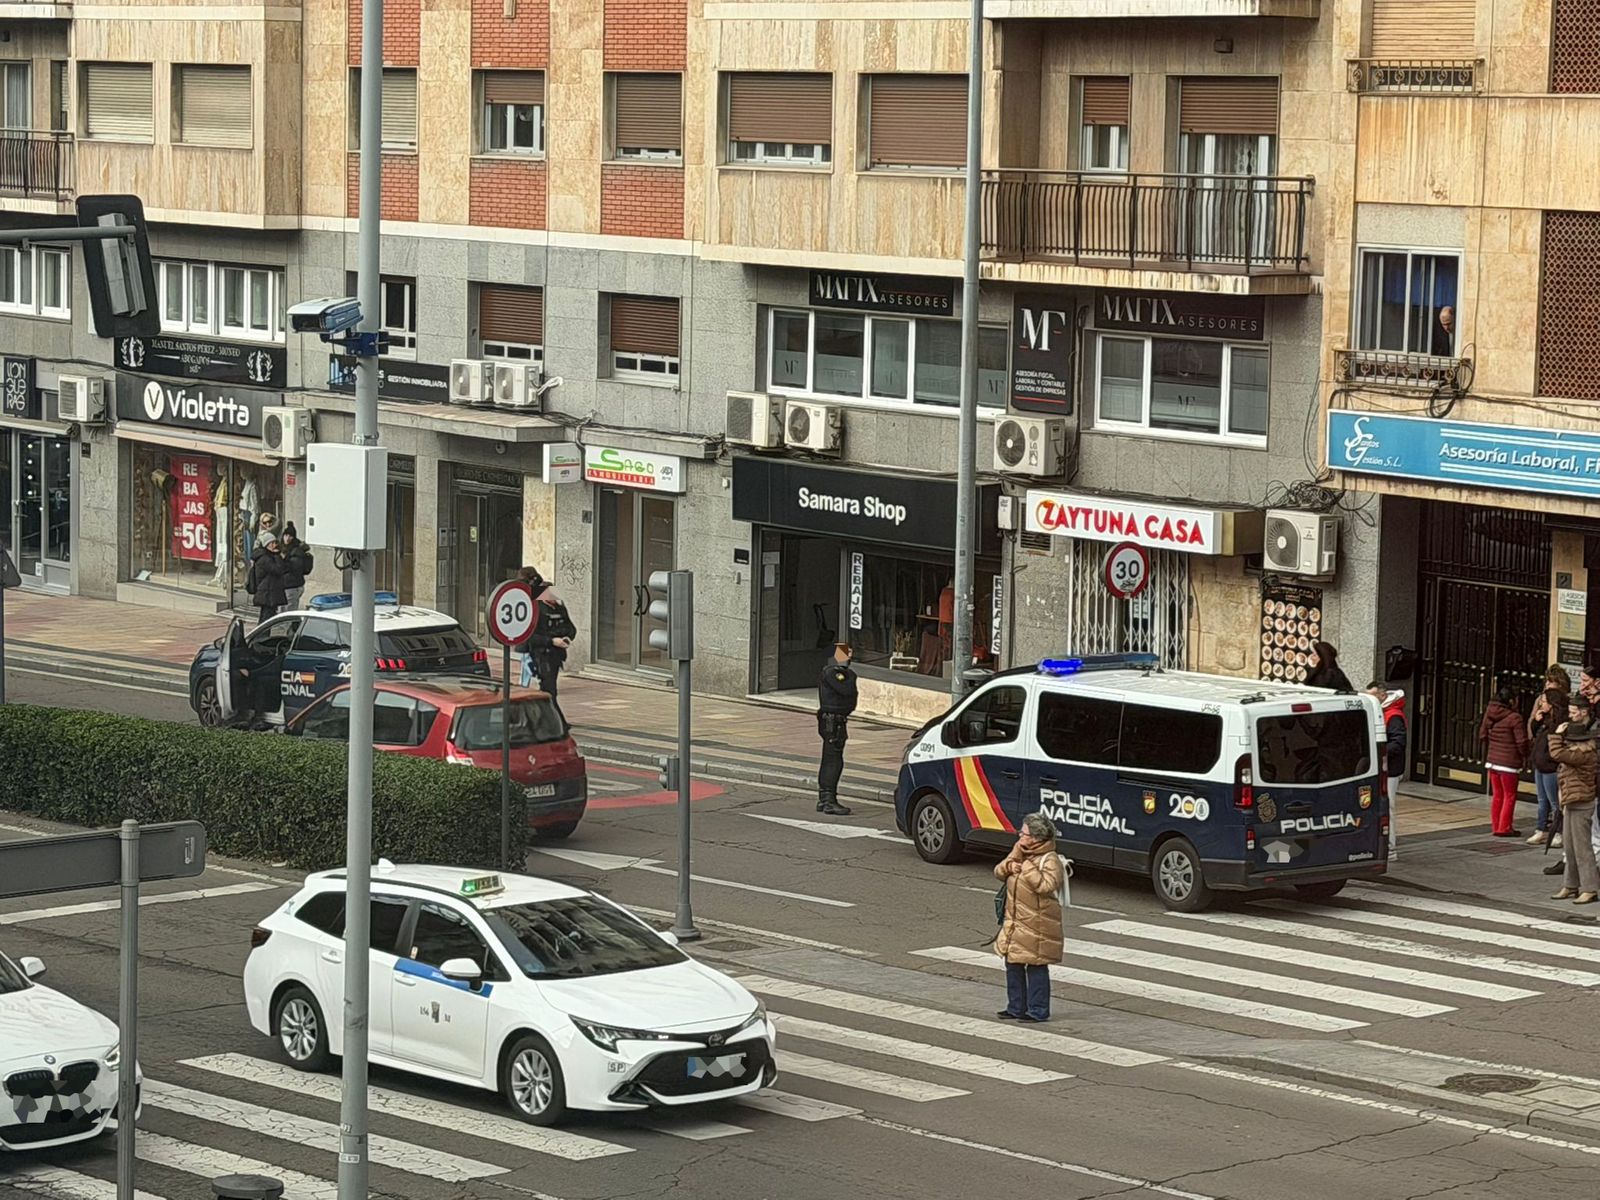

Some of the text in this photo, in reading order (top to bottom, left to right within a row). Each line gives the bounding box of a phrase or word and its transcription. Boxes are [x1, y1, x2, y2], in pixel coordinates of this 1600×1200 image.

[880, 293, 948, 309] ASESORES
[1177, 316, 1258, 332] ASESORES
[411, 377, 448, 389] INMOBILIARIA
[1015, 377, 1037, 385] LABORAL
[1041, 379, 1066, 388] CONTABLE
[1042, 387, 1066, 396] EMPRESAS
[166, 389, 250, 427] Violetta
[1439, 442, 1508, 464] Asesoría
[1511, 450, 1580, 475] Laboral,
[798, 487, 907, 526] Samara Shop
[1041, 499, 1205, 546] ZAYTUNA CASA
[1116, 560, 1140, 580] 30
[851, 554, 862, 627] REBAJAS
[501, 601, 528, 625] 30
[1040, 788, 1113, 814] POLICÍA
[1168, 793, 1210, 821] 200
[1040, 804, 1136, 836] NACIONAL
[1280, 811, 1356, 834] POLICÍA
